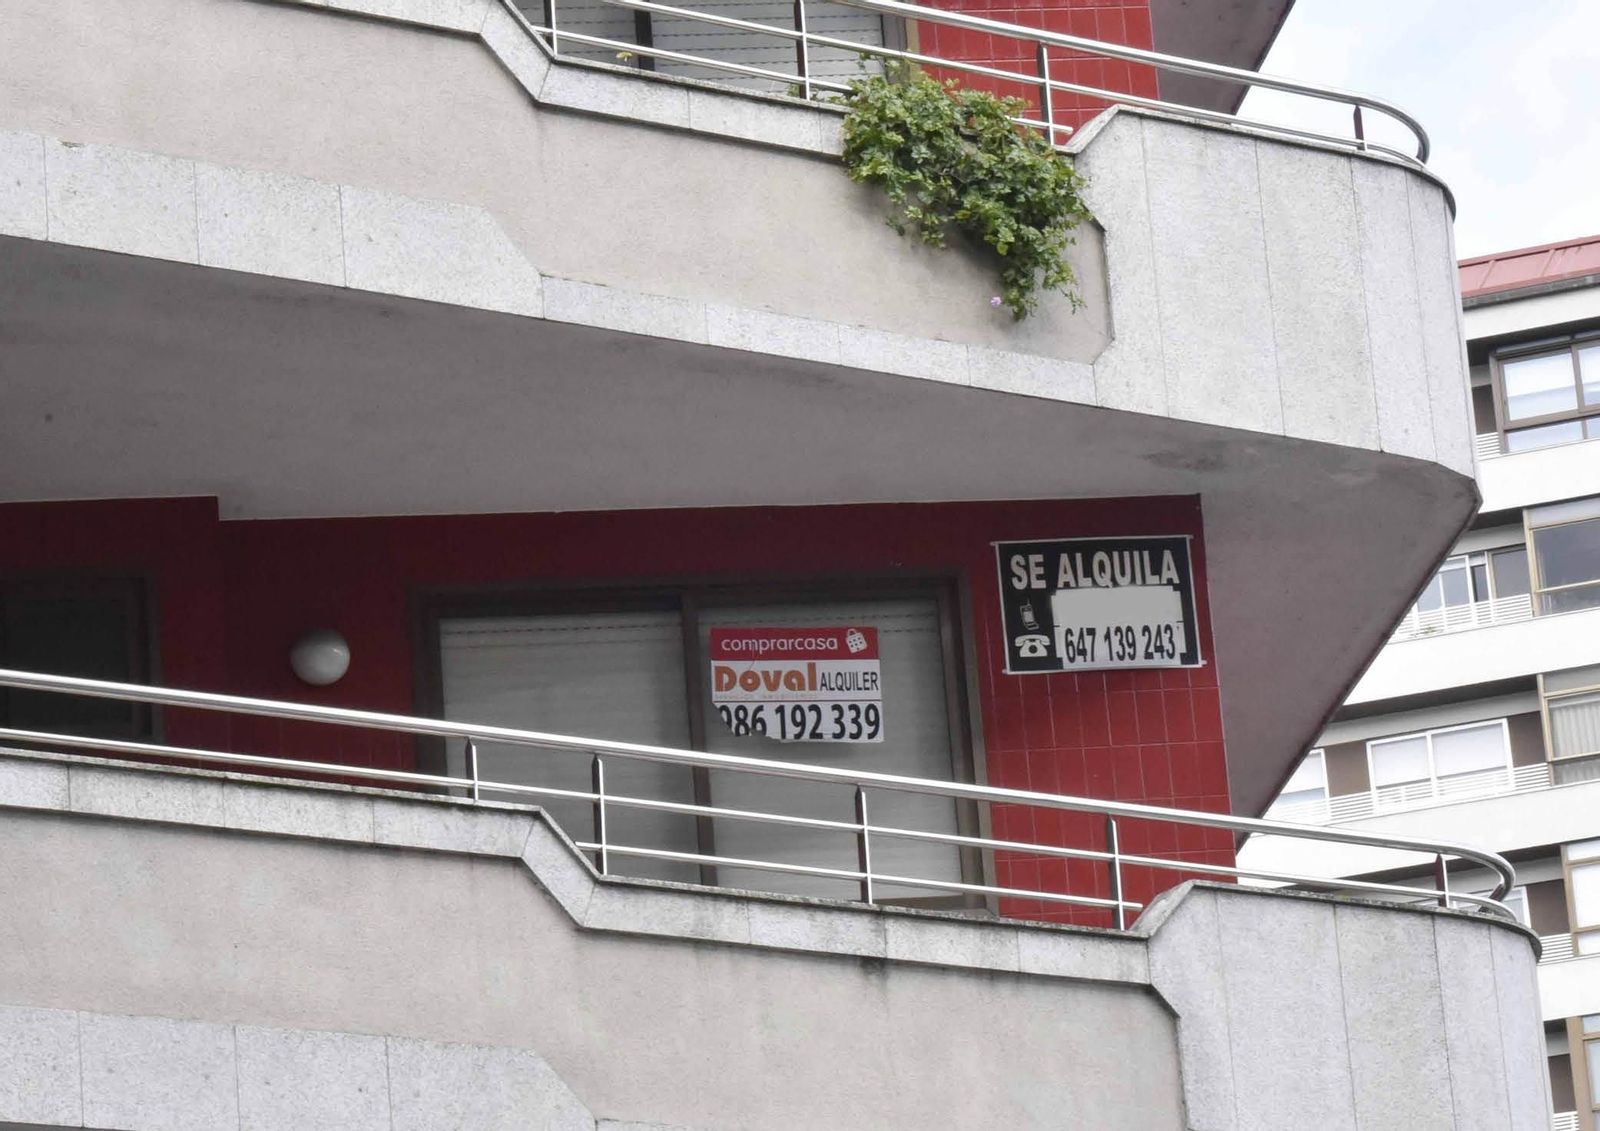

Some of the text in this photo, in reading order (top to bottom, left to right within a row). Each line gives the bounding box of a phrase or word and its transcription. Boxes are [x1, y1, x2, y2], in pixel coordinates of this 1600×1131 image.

[1010, 549, 1180, 590] SE ALQUILA
[721, 637, 838, 654] comprarcasa
[1064, 623, 1176, 663] 647 139 243
[714, 662, 879, 692] Doval ALQUILER
[774, 704, 824, 740] 192
[831, 703, 880, 740] 339
